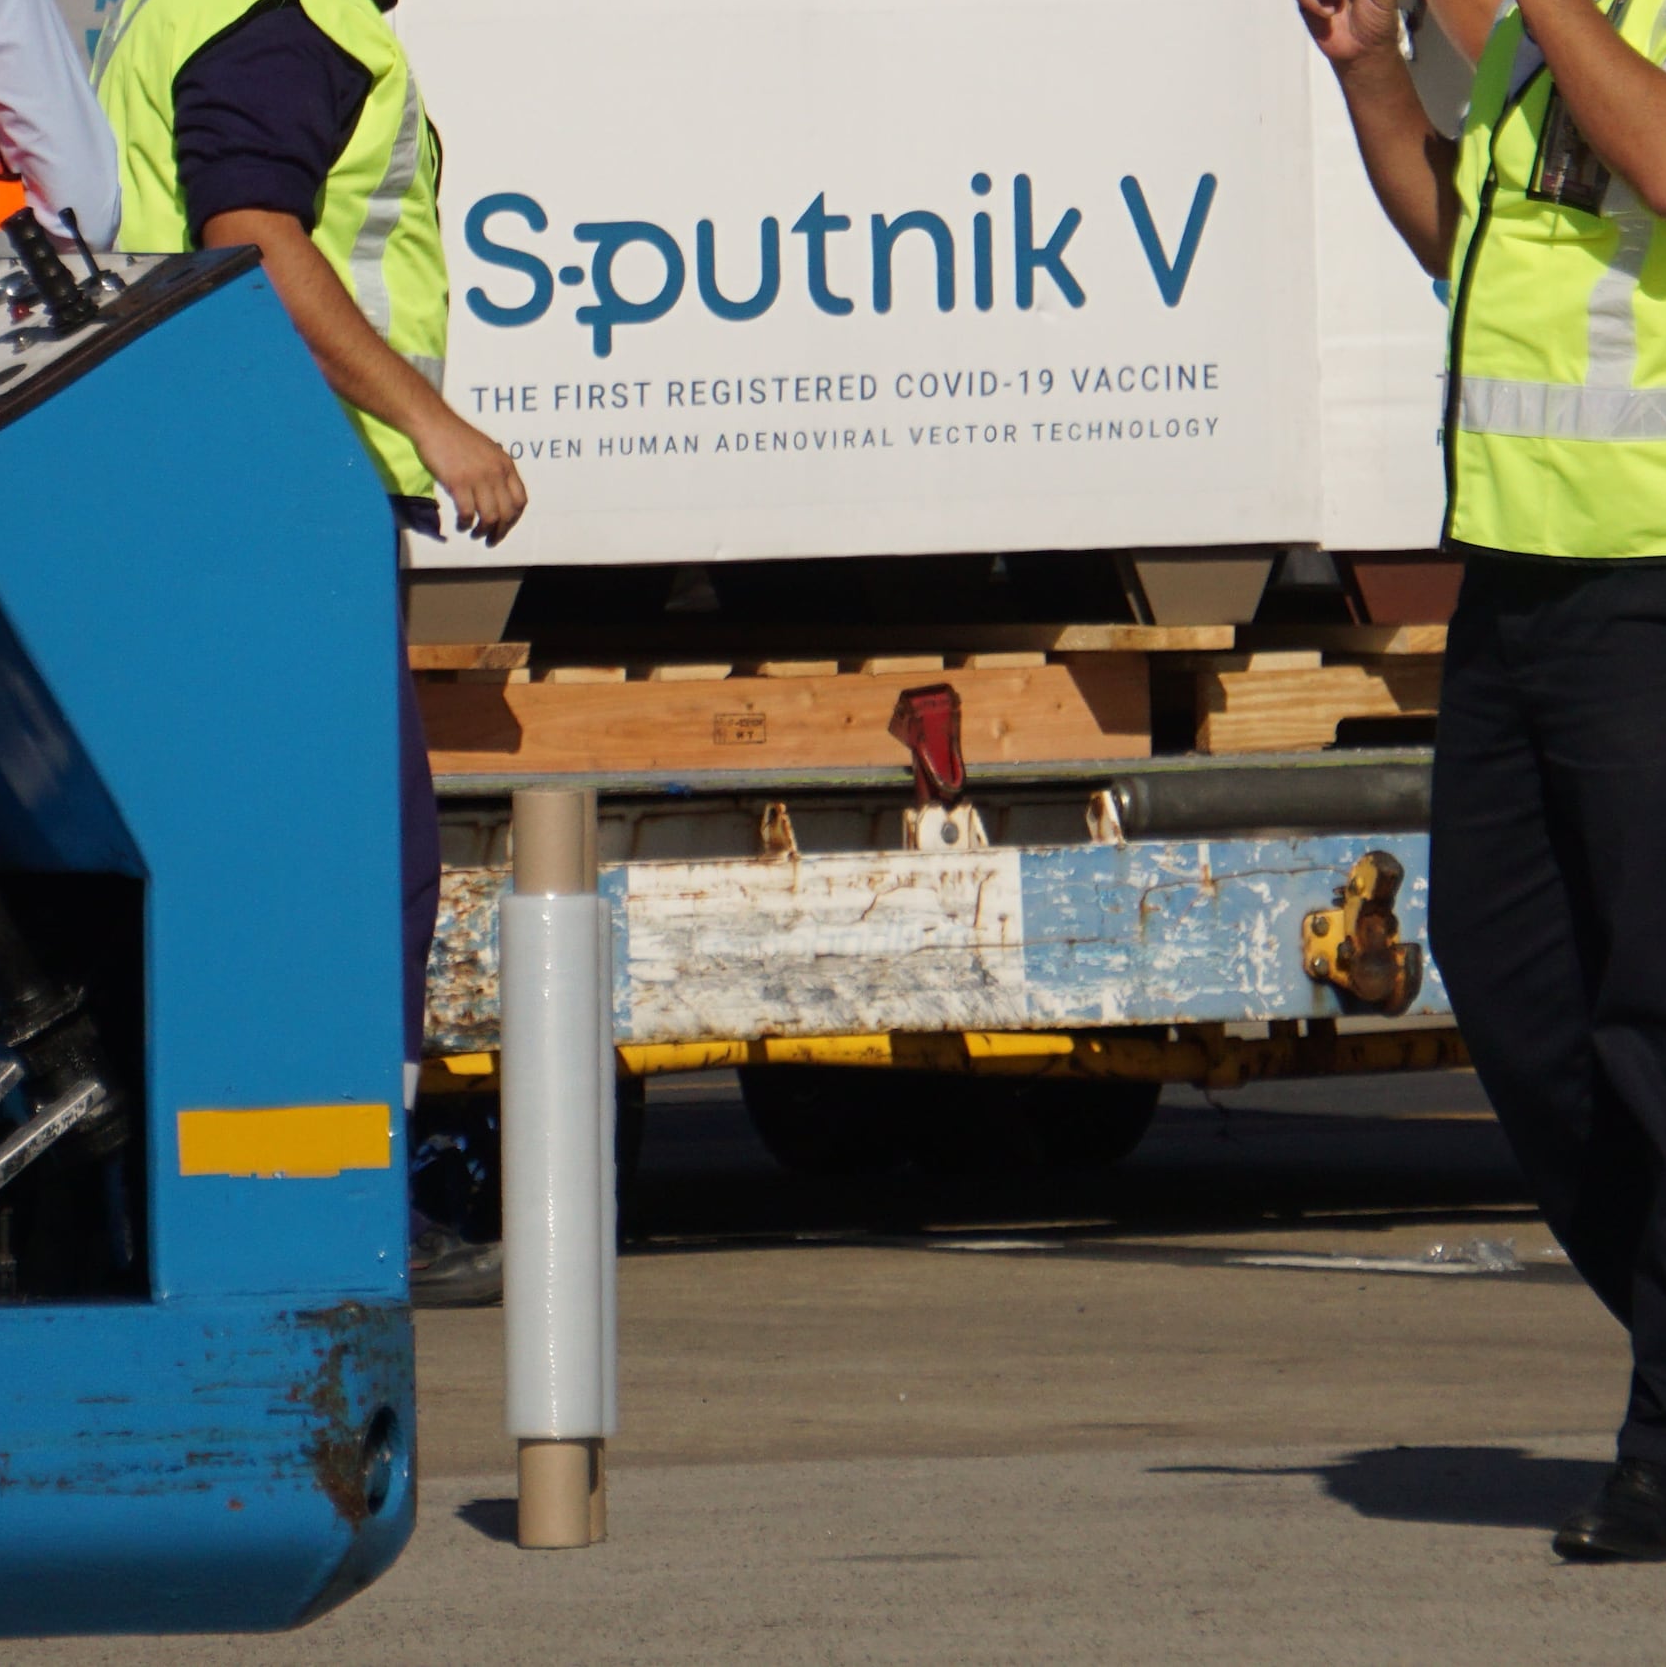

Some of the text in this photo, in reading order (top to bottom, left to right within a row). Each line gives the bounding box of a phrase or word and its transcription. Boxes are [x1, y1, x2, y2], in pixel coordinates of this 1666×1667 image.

[464, 172, 1218, 358] Sputnik V
[471, 364, 1219, 413] THE FIRST REGISTERED COVID-19 VACCINE
[598, 434, 699, 457] HUMAN
[715, 428, 894, 455] ADENOVIRAL
[909, 423, 1017, 445] VECTOR
[1033, 417, 1219, 443] TECHNOLOGY
